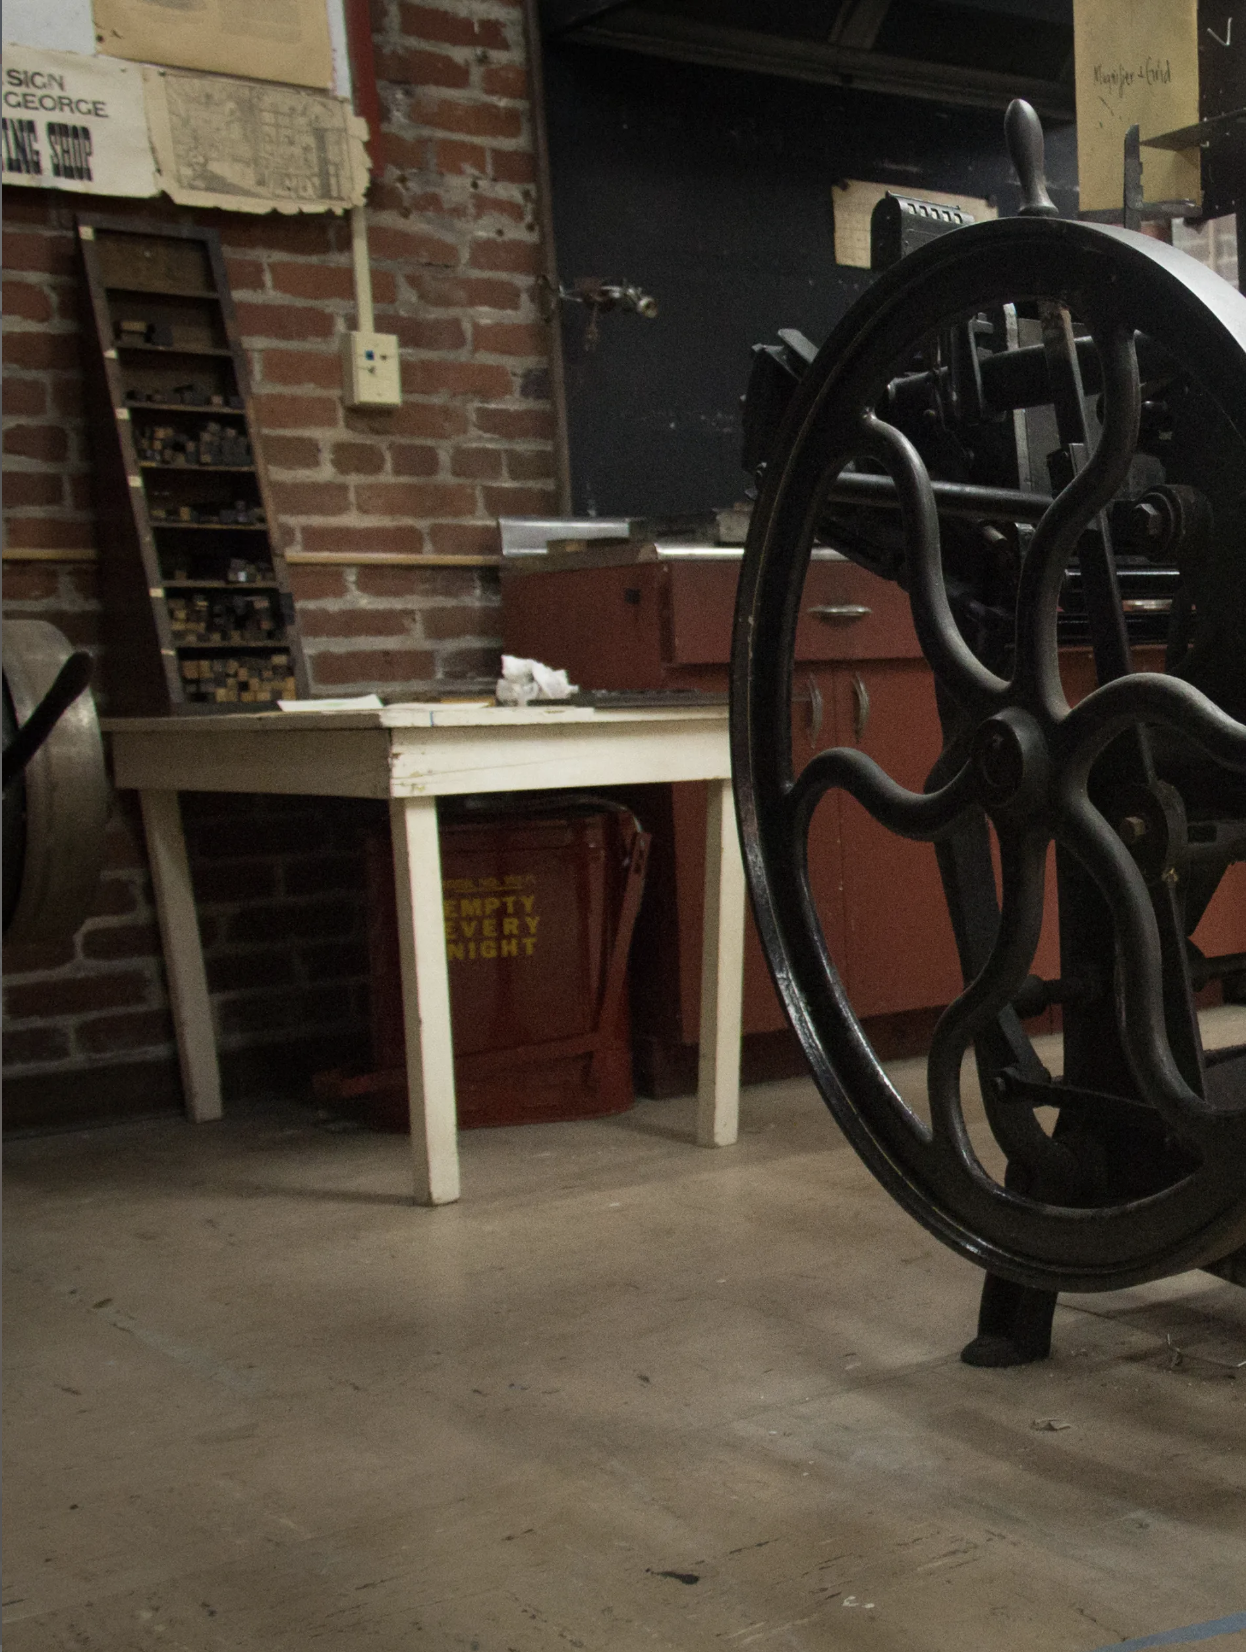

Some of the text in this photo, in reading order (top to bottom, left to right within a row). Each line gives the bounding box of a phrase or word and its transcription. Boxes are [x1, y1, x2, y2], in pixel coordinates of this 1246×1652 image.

[2, 68, 65, 91] SIGN
[4, 91, 109, 118] GEORGE
[2, 118, 93, 181] ING SHOP
[444, 896, 535, 917] EMPTY
[445, 916, 540, 940] EVERY
[446, 937, 537, 960] NIGHT
